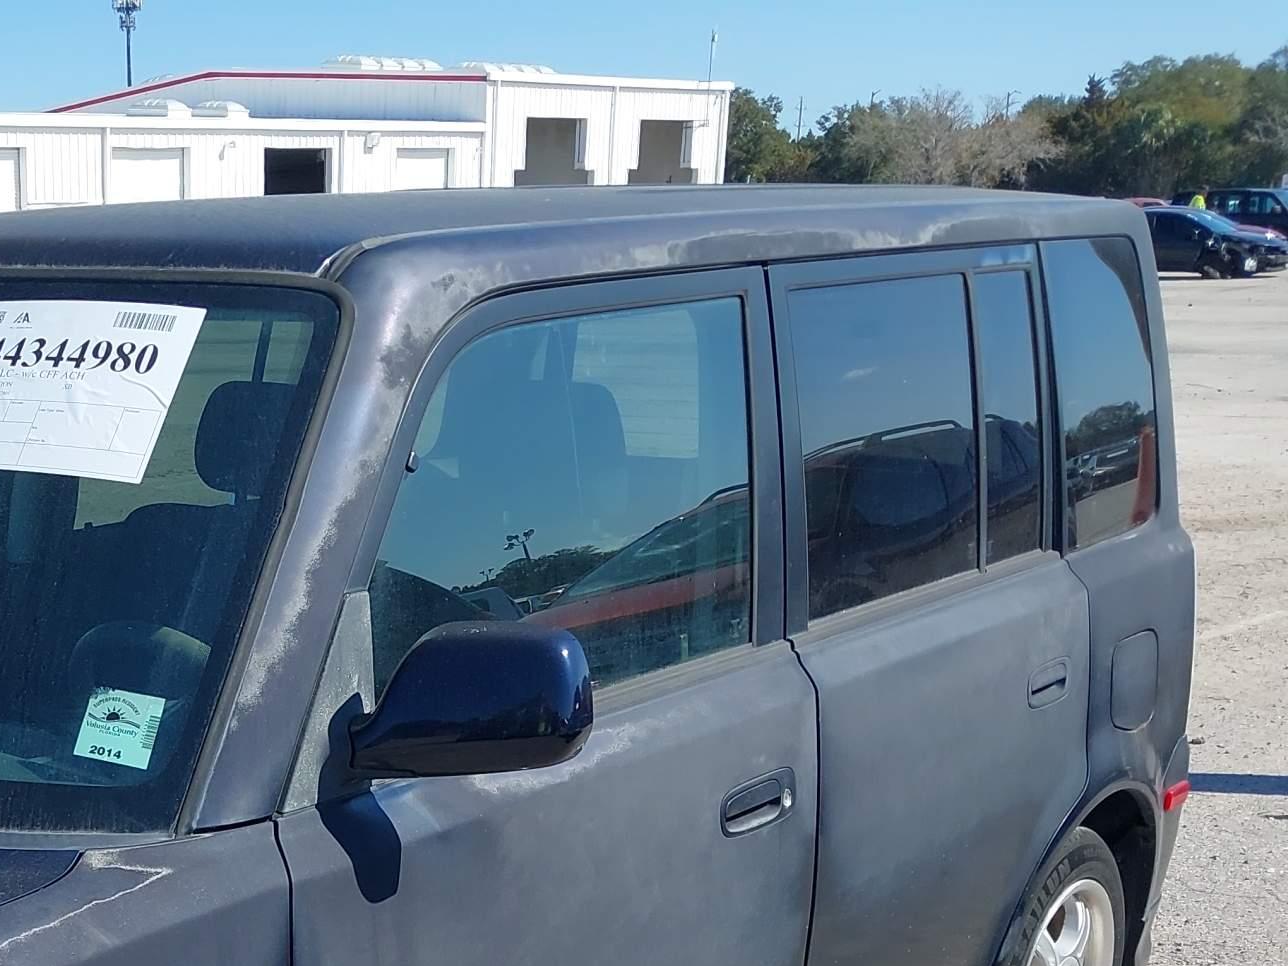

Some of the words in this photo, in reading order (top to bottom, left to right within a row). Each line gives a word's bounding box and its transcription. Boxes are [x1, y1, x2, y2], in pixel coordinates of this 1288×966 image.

[39, 370, 61, 380] CFF
[60, 371, 87, 382] ACH
[86, 720, 111, 731] Volusia
[112, 726, 139, 739] County
[88, 745, 122, 759] 2014
